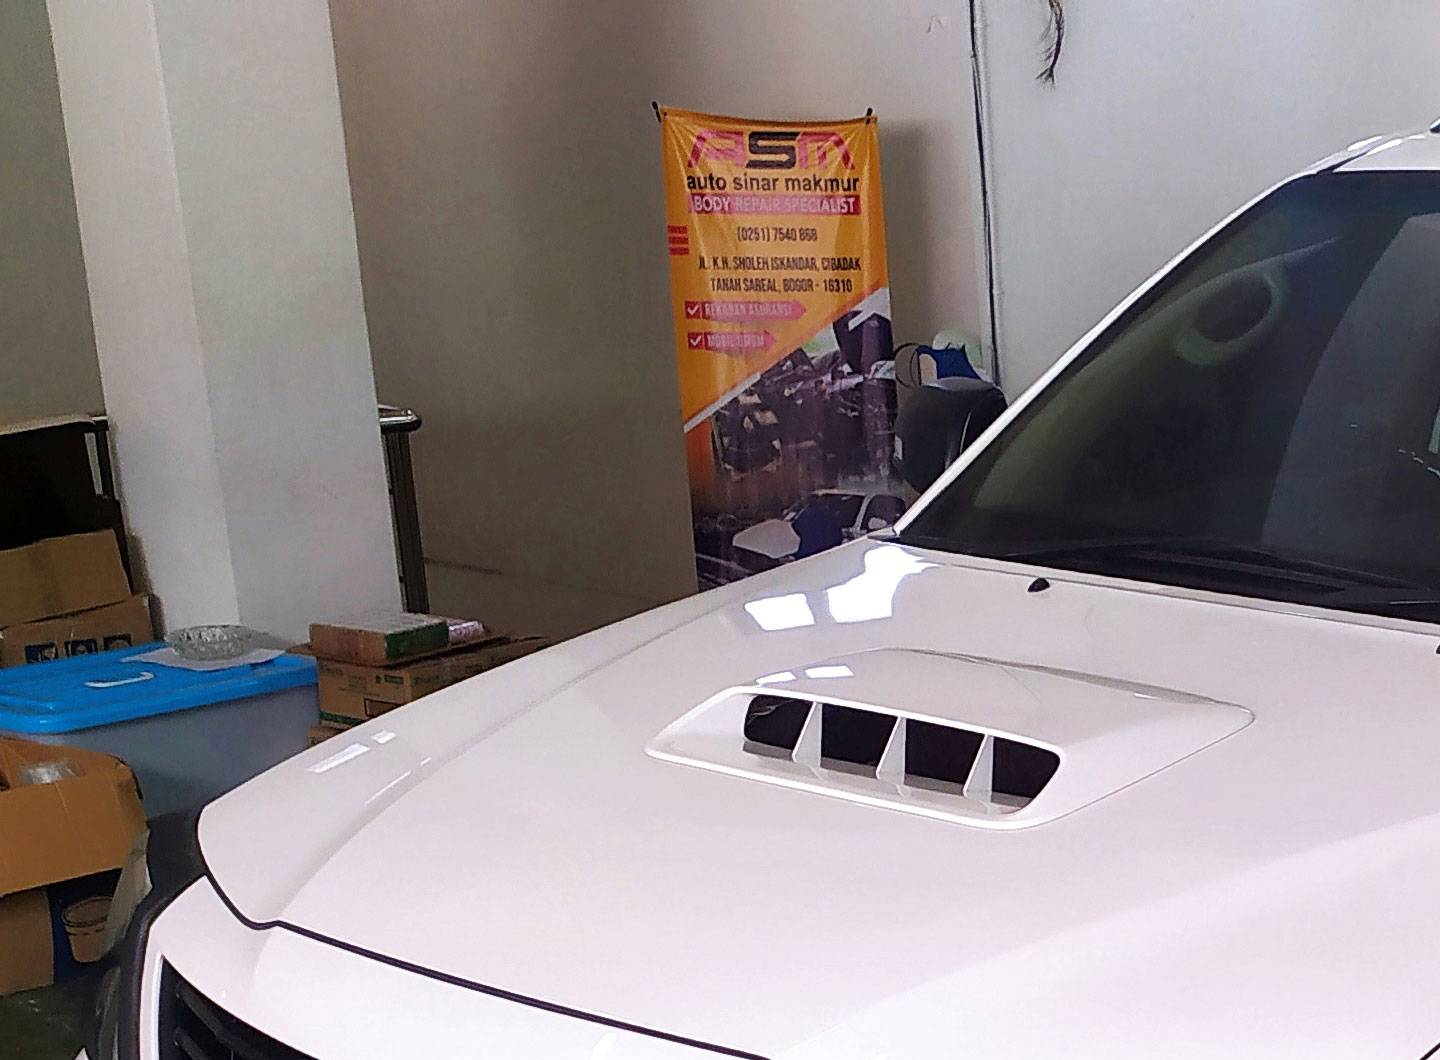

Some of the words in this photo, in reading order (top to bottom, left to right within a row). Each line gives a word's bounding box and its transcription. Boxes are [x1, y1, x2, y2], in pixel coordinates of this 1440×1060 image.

[687, 175, 726, 190] auto
[733, 172, 779, 191] sinar
[785, 174, 859, 192] makmur
[693, 196, 731, 212] BODY
[735, 197, 782, 212] REPAIR
[784, 197, 856, 212] SPECIALIST
[733, 256, 769, 270] SHOLEH
[771, 256, 820, 272] ISKANDAR,
[821, 257, 862, 271] CIBADAK
[711, 278, 742, 292] TANAH
[743, 278, 781, 293] SAREAL,
[823, 278, 853, 293] 16310
